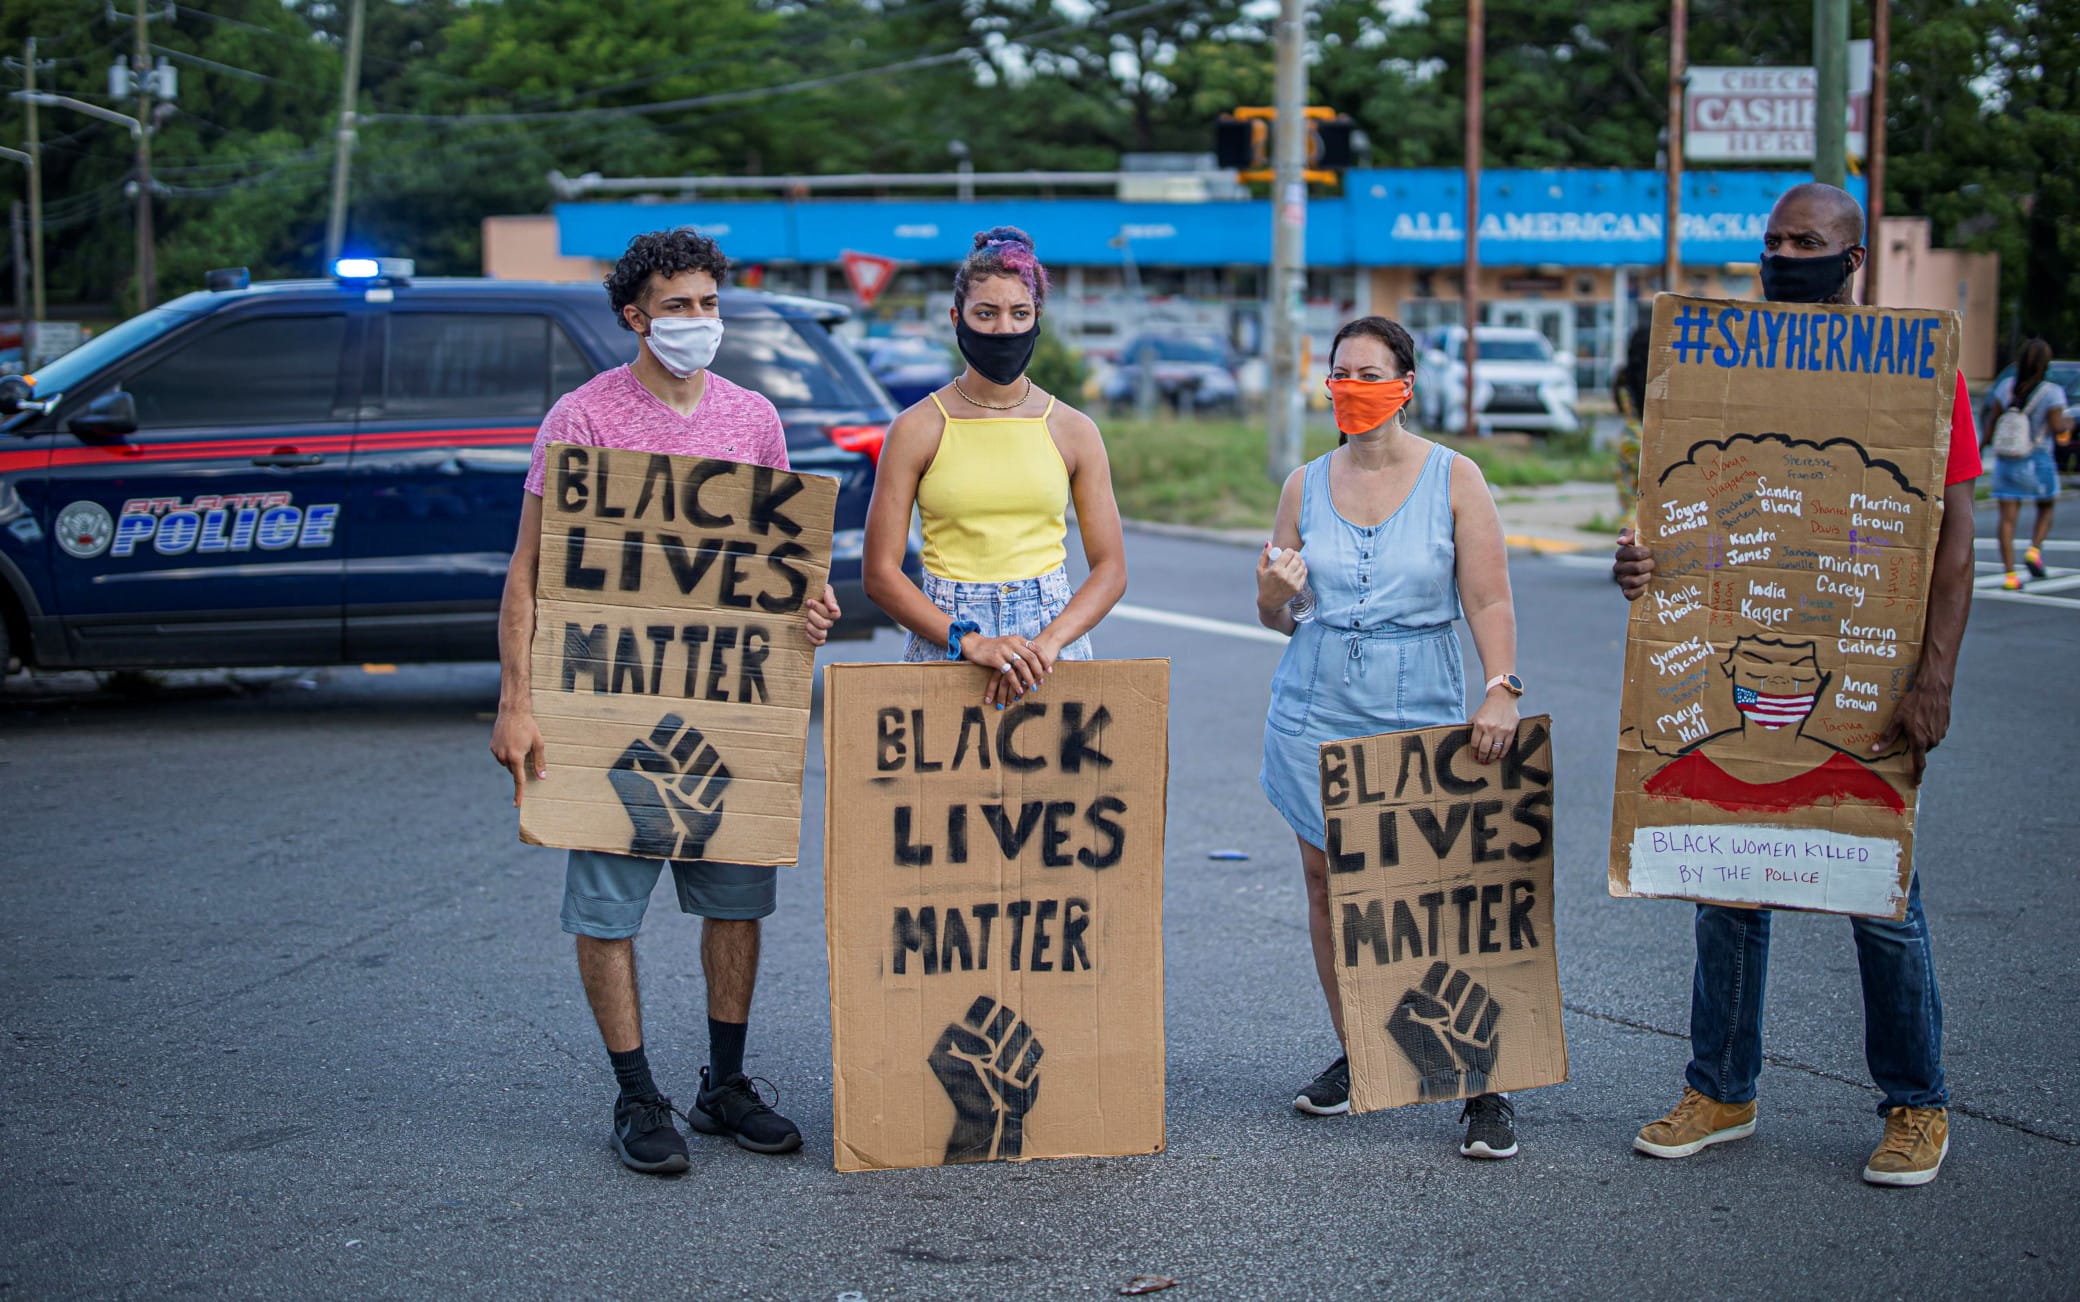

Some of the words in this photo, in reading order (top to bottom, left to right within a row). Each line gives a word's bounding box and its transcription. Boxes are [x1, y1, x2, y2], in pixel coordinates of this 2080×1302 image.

[1391, 213, 1463, 241] ALL
[1477, 213, 1661, 241] AMERICAN
[1672, 305, 1941, 379] #SAYHERNAME
[557, 447, 805, 537] BLACK
[1755, 476, 1802, 502] Sandra
[122, 492, 291, 514] ATLANTA
[1662, 500, 1708, 522] Joyce
[1760, 499, 1801, 517] Bland
[1849, 493, 1910, 514] Martina
[110, 504, 339, 556] POLICE
[1852, 513, 1904, 534] Brown
[1726, 547, 1771, 565] James
[1818, 554, 1880, 580] Miriam
[565, 527, 809, 614] LIVES
[1654, 585, 1701, 609] Kayla
[1748, 580, 1786, 599] India
[1816, 575, 1865, 607] Carey
[1658, 600, 1701, 625] Moore
[1741, 599, 1793, 626] Kager
[1840, 619, 1896, 644] Korryn
[562, 622, 770, 704] MATTER
[1841, 675, 1879, 696] Anna
[1835, 693, 1877, 712] Brown
[876, 702, 1113, 774] BLACK
[1678, 717, 1710, 743] Hall
[1321, 723, 1553, 807] BLACK
[894, 795, 1127, 870] LIVES
[1326, 790, 1553, 874] LIVES
[1652, 831, 1725, 855] BLACK
[1732, 838, 1797, 859] WOMEN
[1805, 843, 1869, 862] KILLED
[1679, 864, 1704, 884] BY
[1714, 866, 1751, 882] THE
[1765, 868, 1820, 884] POLICE
[892, 898, 1092, 975] MATTER
[1342, 879, 1540, 968] MATTER
